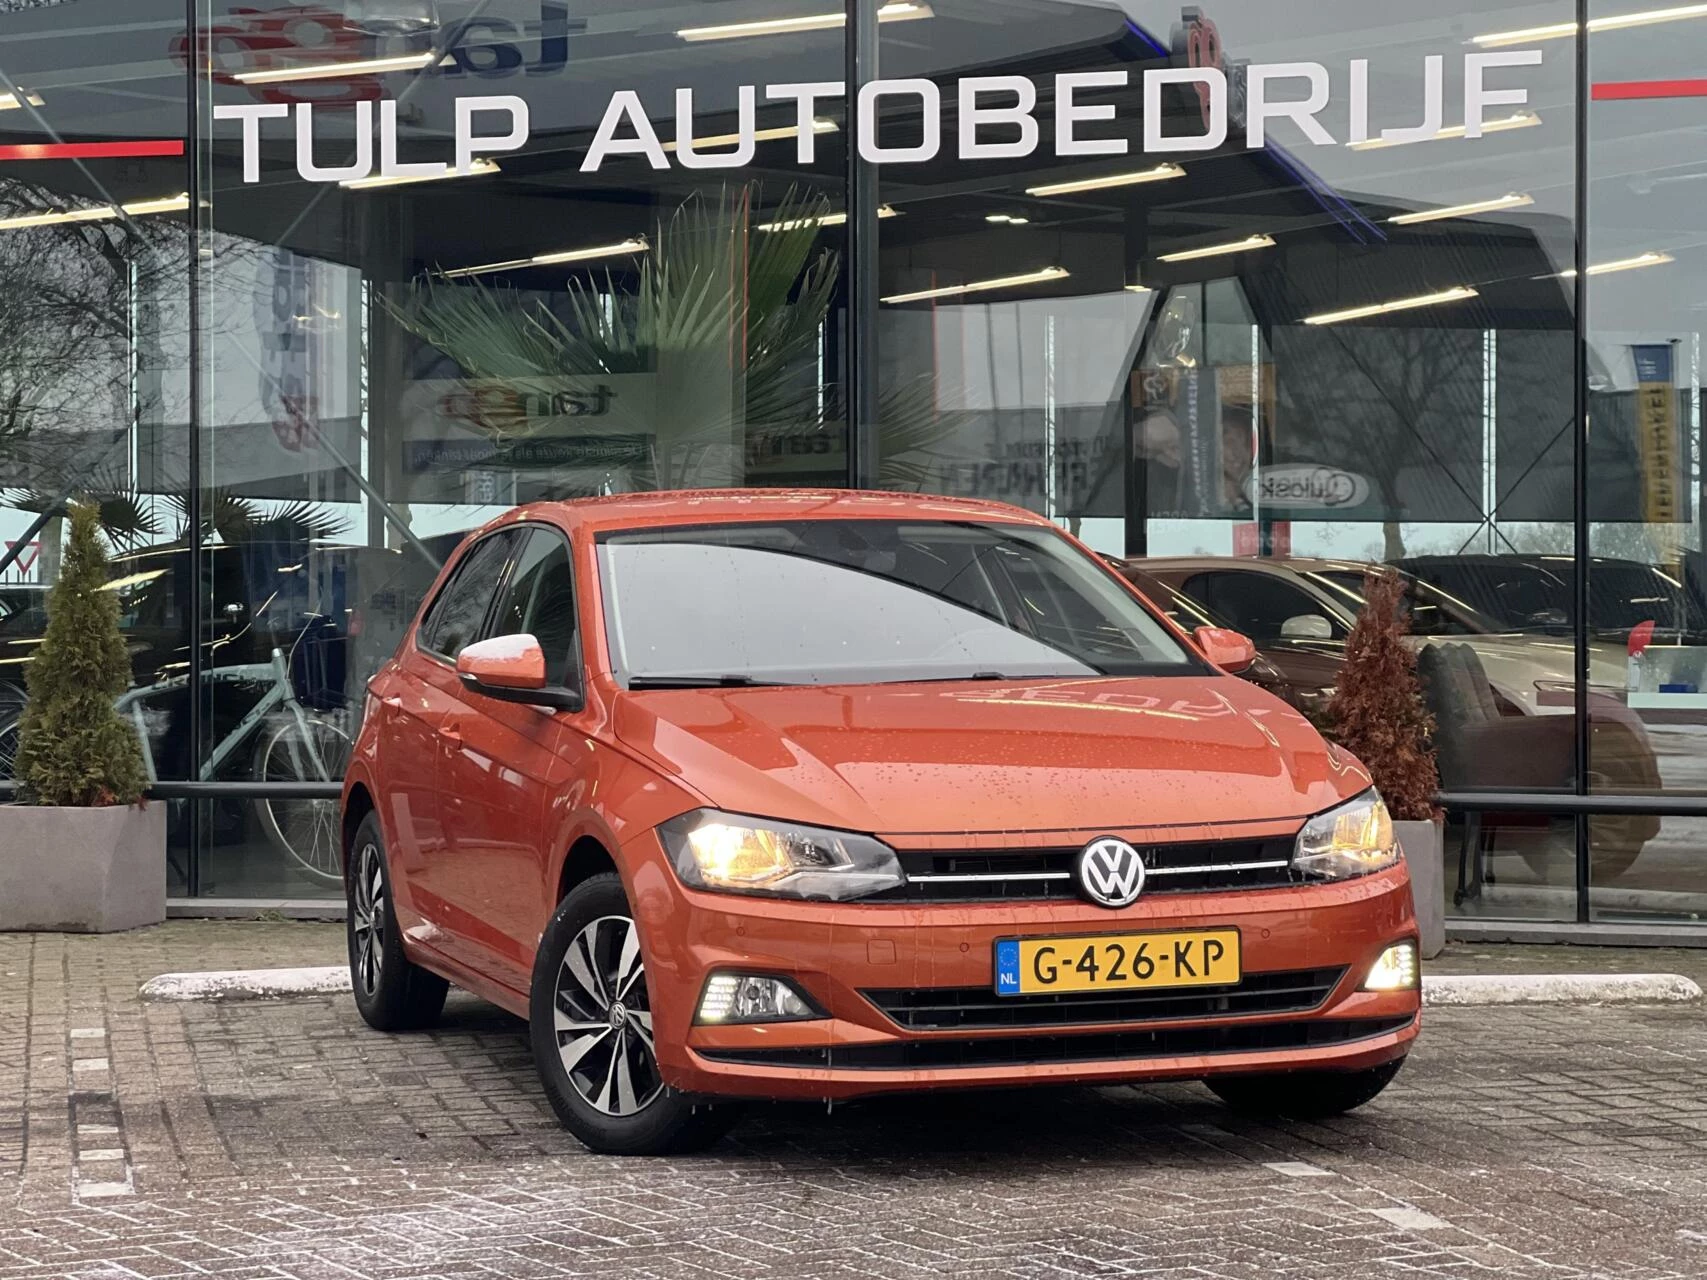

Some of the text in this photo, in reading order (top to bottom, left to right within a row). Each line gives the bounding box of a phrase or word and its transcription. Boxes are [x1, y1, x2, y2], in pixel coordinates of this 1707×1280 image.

[213, 50, 1543, 183] TULP AUTOBEDRIJF
[1000, 939, 1225, 985] NL G-426-KP
